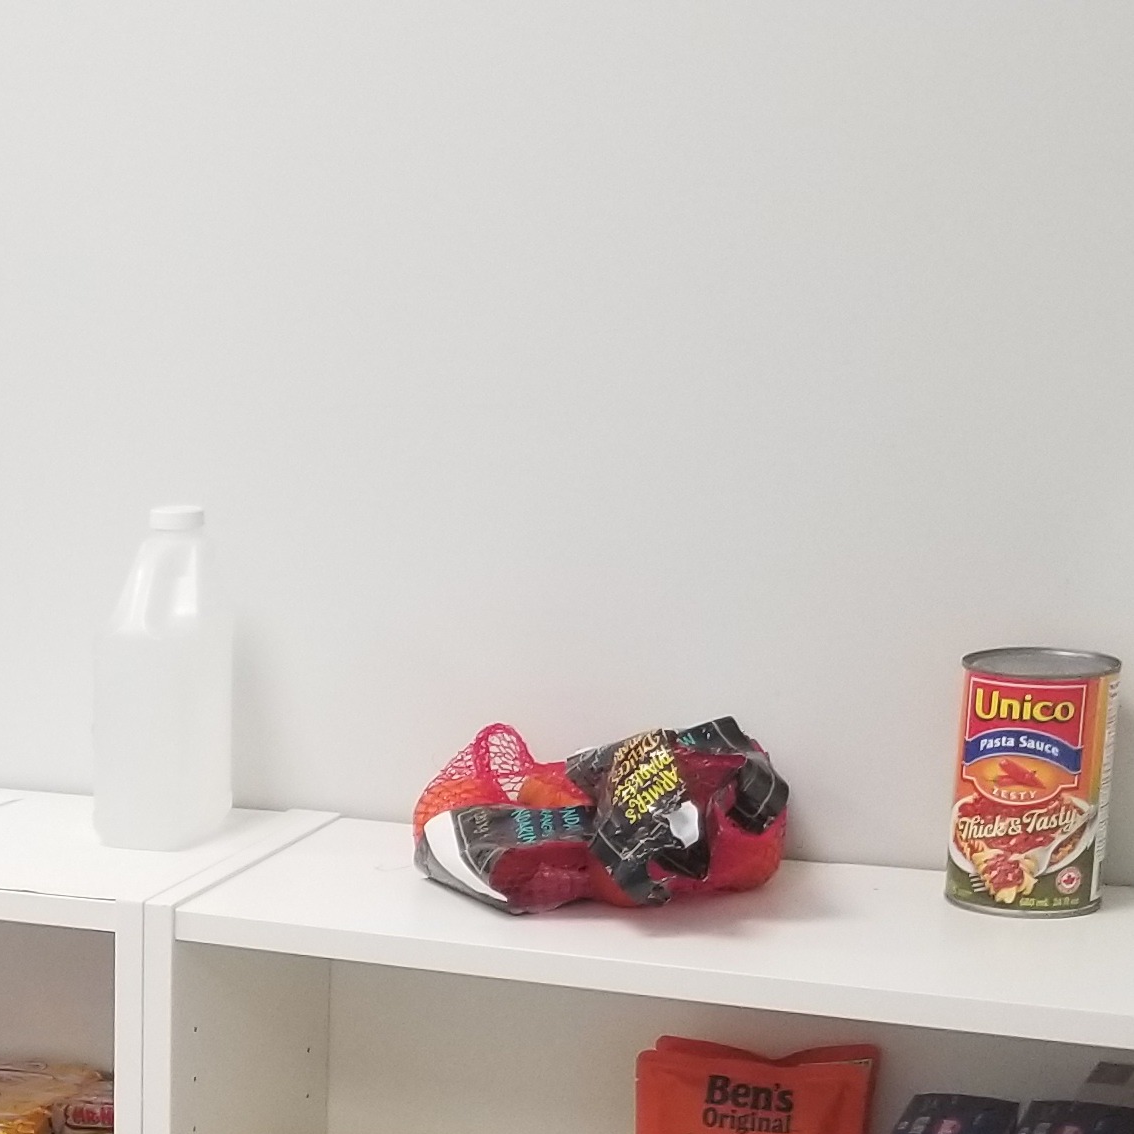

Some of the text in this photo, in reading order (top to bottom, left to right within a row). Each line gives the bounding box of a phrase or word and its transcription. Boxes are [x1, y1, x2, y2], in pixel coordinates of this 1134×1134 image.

[974, 687, 1076, 722] Unico
[979, 735, 1060, 756] Pasta Sauce
[624, 763, 678, 825] ARMER'S
[991, 787, 1037, 801] ZESTY
[959, 806, 1078, 840] Thick & Tasty
[704, 1074, 794, 1113] Ben's
[702, 1106, 792, 1134] Original
